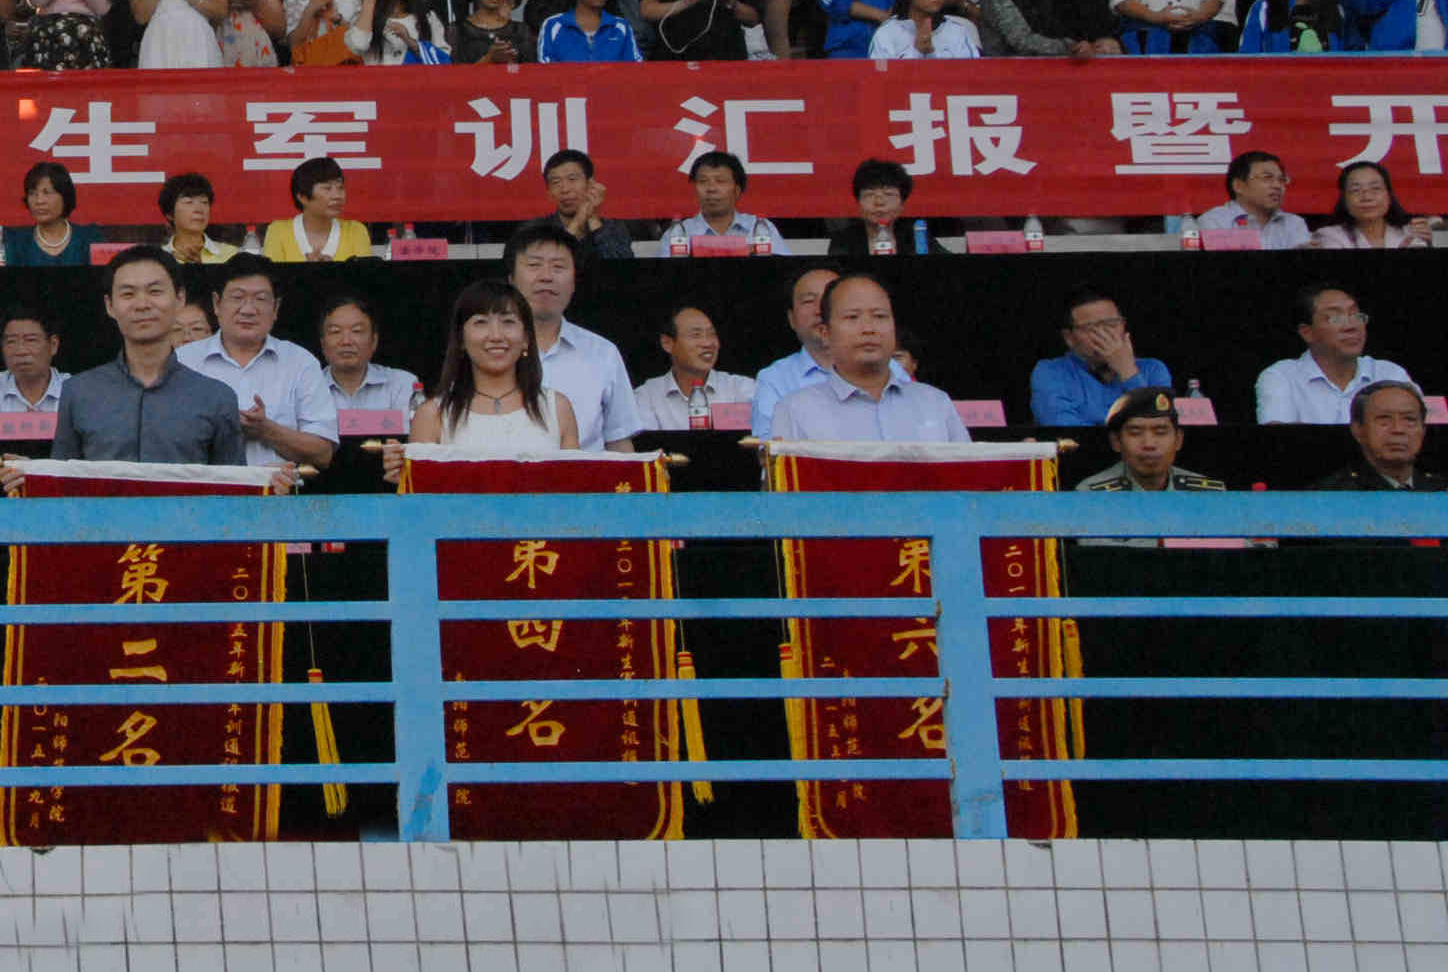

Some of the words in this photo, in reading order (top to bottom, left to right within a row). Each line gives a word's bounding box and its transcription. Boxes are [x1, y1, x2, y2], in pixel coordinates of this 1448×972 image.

[99, 543, 170, 766] 第二名
[504, 540, 567, 747] 第四名
